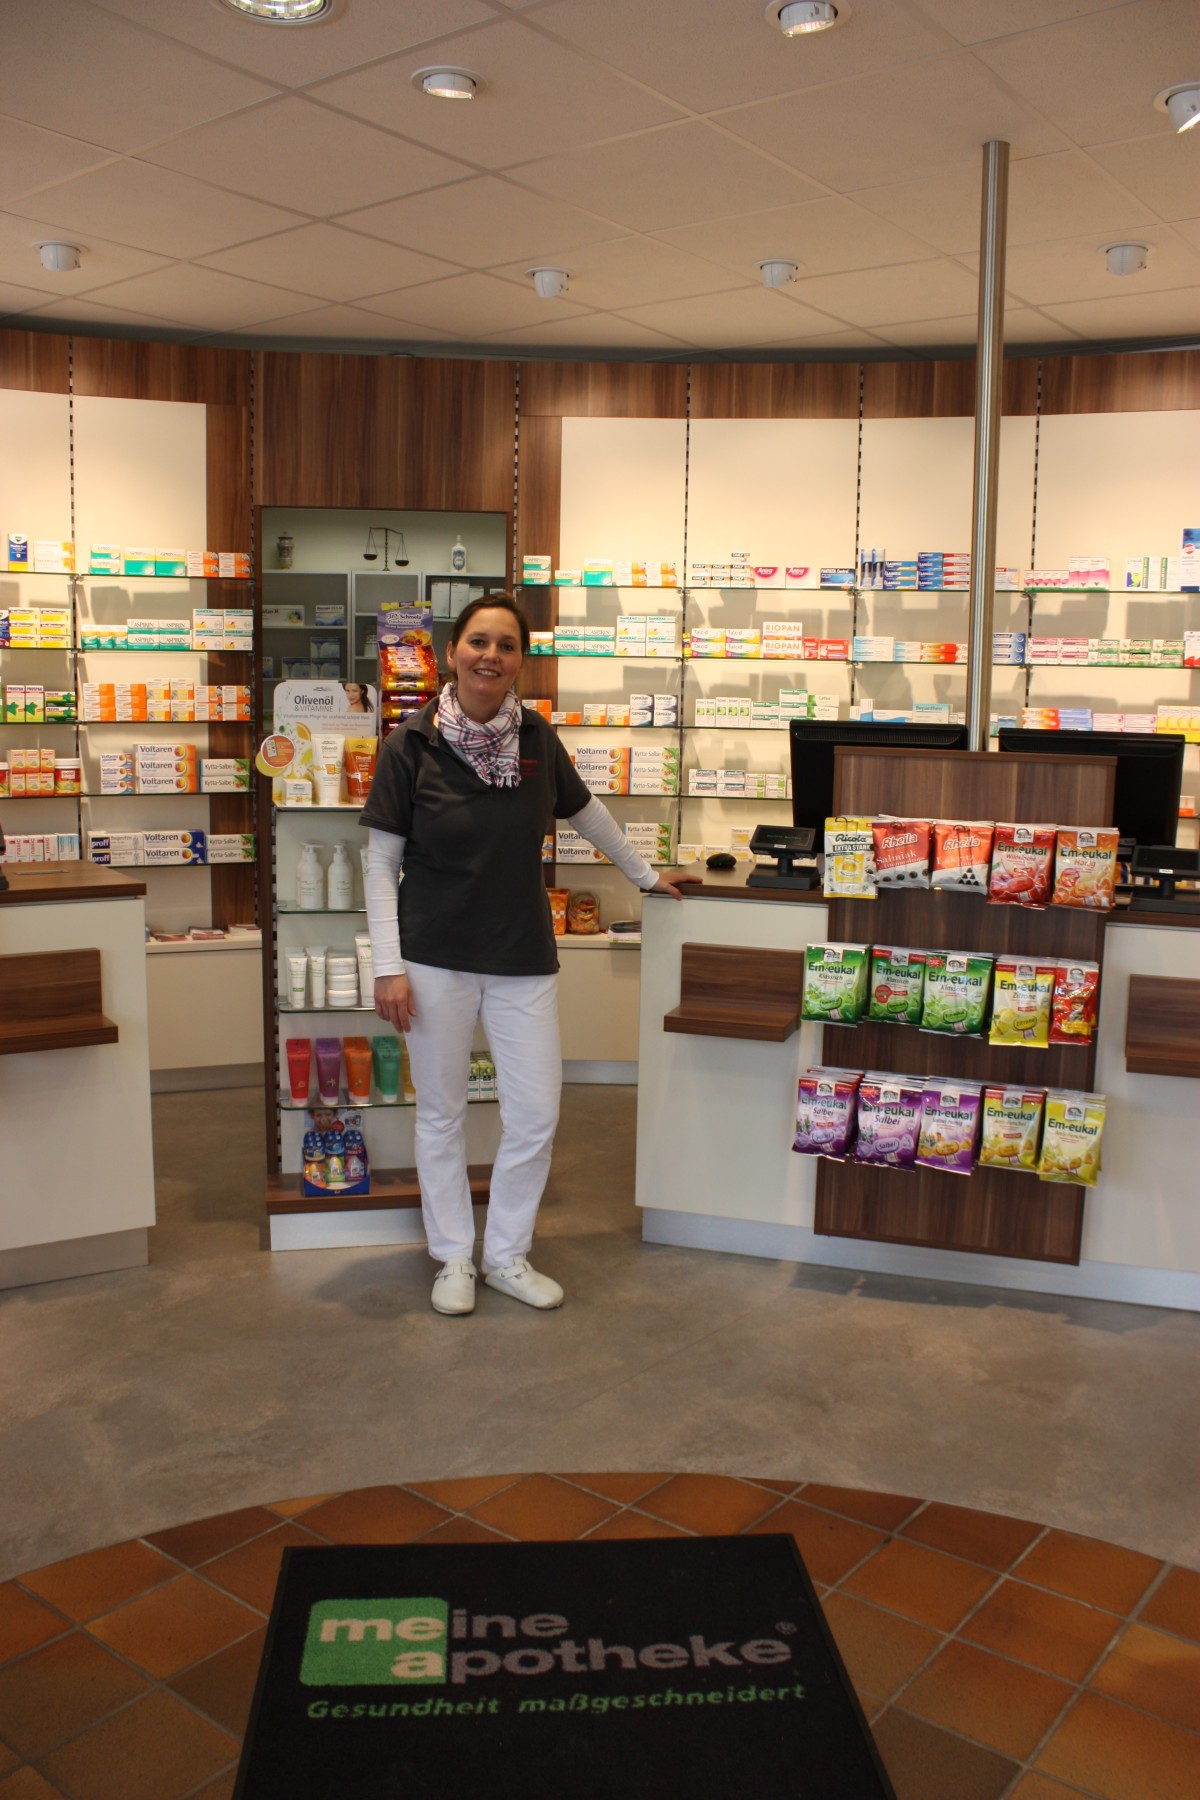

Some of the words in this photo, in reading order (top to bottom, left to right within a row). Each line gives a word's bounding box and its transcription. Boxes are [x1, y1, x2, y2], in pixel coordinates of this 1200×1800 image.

[294, 695, 334, 705] Olivenöl
[205, 763, 232, 771] Kytta-Salbe
[634, 766, 660, 774] Kytta-Salbe
[205, 779, 232, 787] Kytta-Salbe
[91, 838, 110, 848] proff
[210, 838, 237, 846] Kytta-Salbe
[835, 834, 867, 842] Ricola
[882, 833, 918, 849] Rheila
[943, 838, 981, 850] Rheila
[210, 851, 238, 859] Kytta-Salbe
[998, 842, 1048, 856] Em-eukal
[1061, 847, 1112, 860] Em-eukal
[91, 853, 110, 864] proff
[877, 850, 917, 864] Salmiak
[1074, 859, 1096, 868] Honig
[808, 961, 856, 975] Em-eukal
[876, 965, 920, 979] Em-eukal
[819, 973, 843, 981] Klassisch
[928, 972, 982, 986] Em-eukal
[1000, 980, 1050, 993] Em-eukal
[1012, 992, 1037, 1000] Zitrone
[801, 1096, 847, 1109] Em-eukal
[813, 1107, 834, 1116] Salbei
[862, 1102, 915, 1117] Em-eukal
[925, 1106, 973, 1121] Em-eukal
[986, 1106, 1036, 1121] Em-eukal
[874, 1115, 900, 1125] Salbei
[1048, 1118, 1098, 1135] Em-eukal
[878, 1141, 896, 1149] Salbei
[320, 1608, 570, 1642] meine
[390, 1634, 792, 1684] apotheke
[307, 1697, 500, 1719] Gesundheit
[519, 1684, 806, 1714] maßgeschneidert
